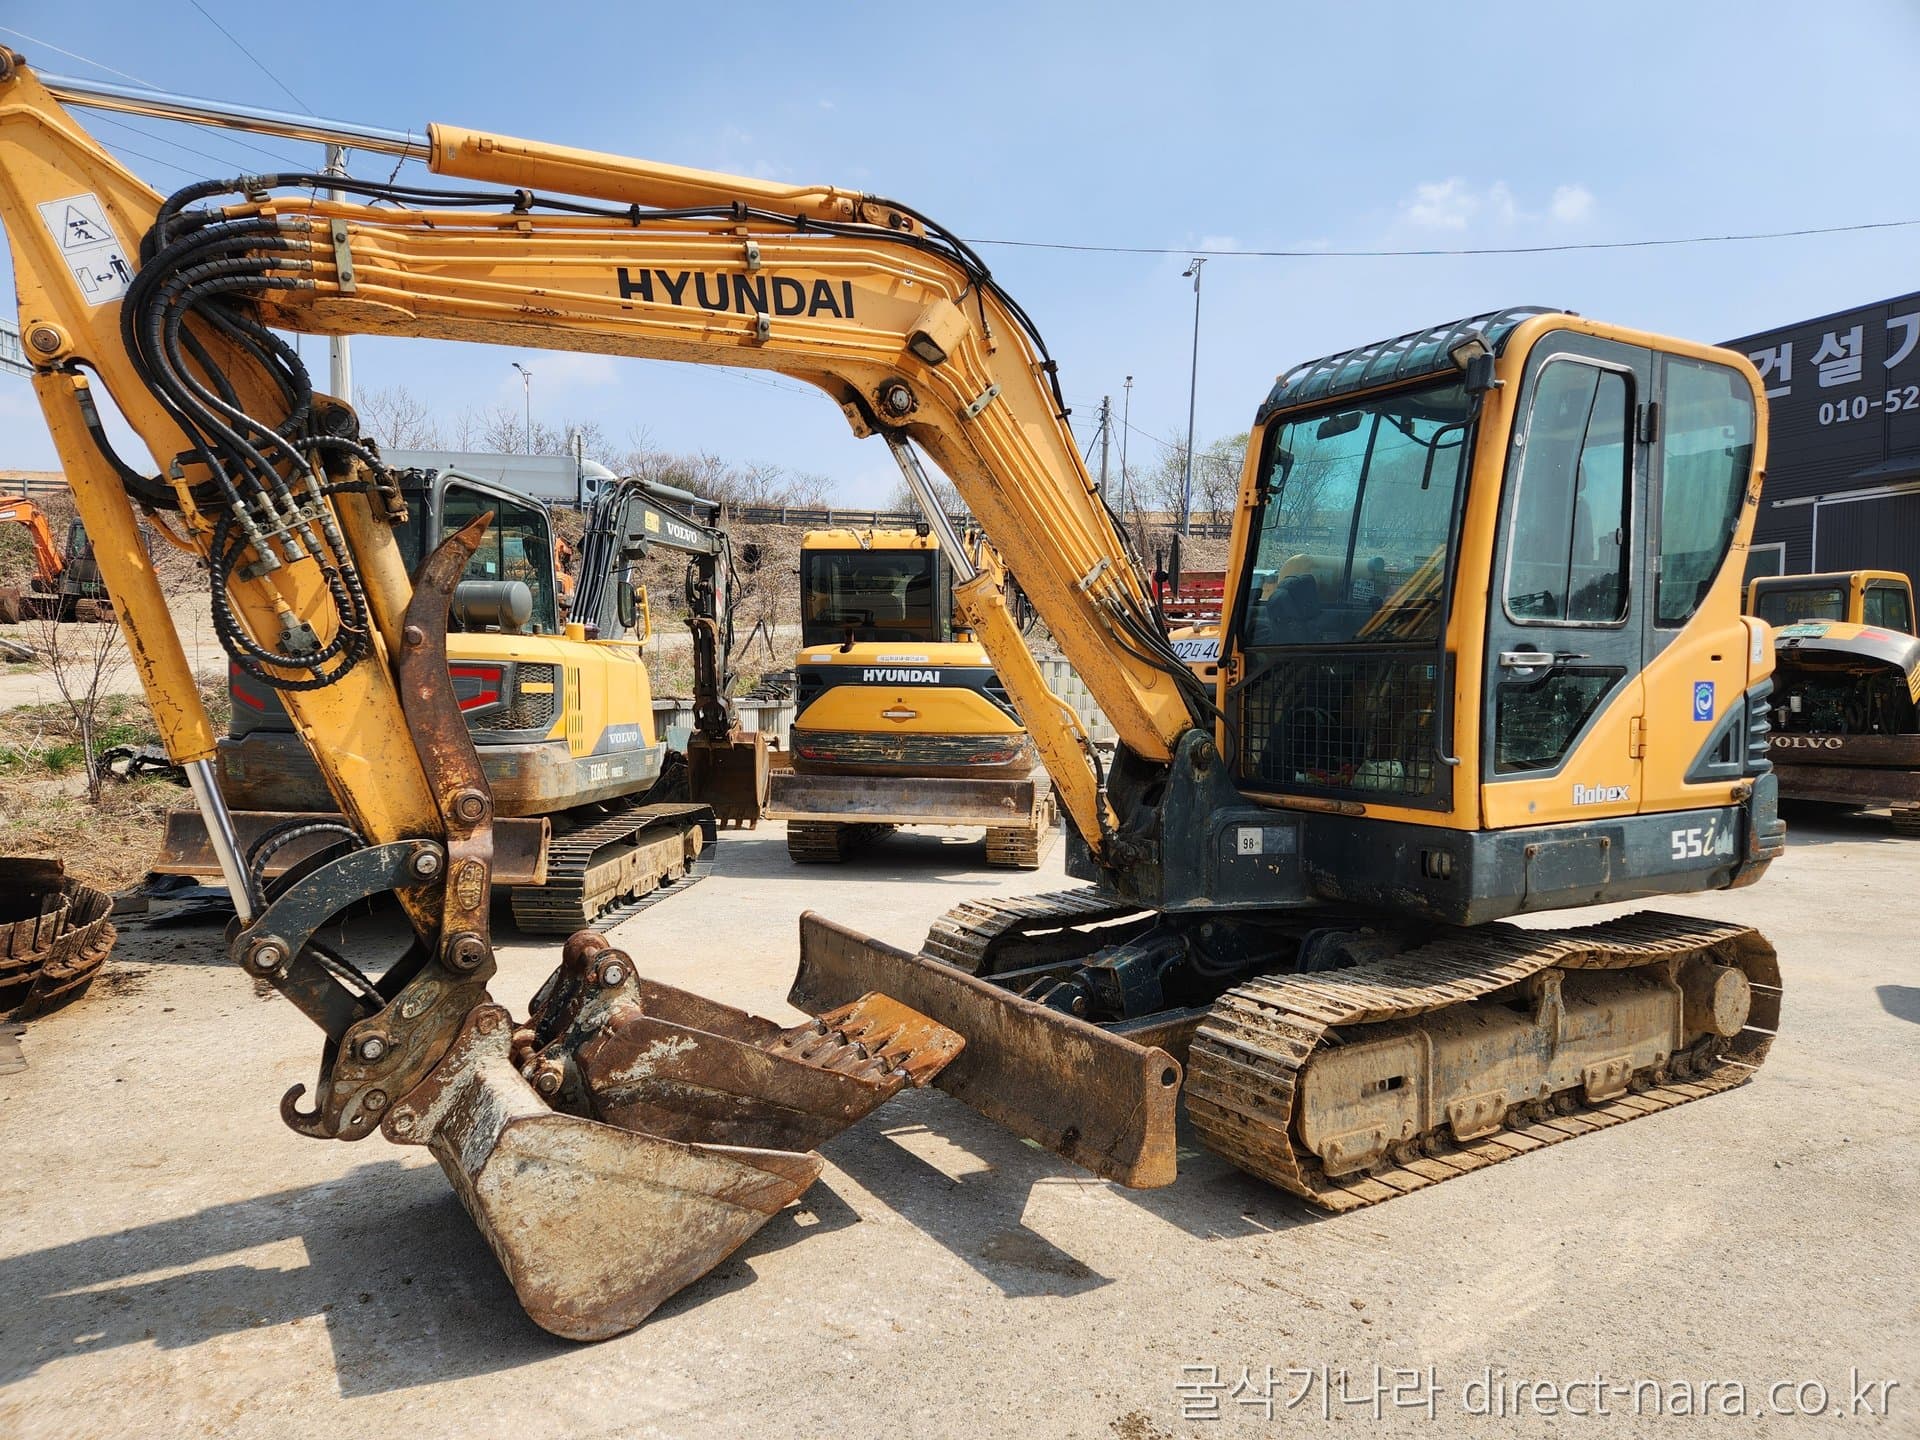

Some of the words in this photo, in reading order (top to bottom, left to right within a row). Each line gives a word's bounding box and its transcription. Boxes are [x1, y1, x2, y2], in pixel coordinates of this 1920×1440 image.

[616, 267, 855, 320] HYUNDAI
[665, 521, 698, 544] VOLVO
[863, 669, 941, 684] HYUNDAI
[608, 731, 638, 744] VOLVO
[1572, 783, 1631, 806] Robex
[1243, 838, 1255, 850] 98
